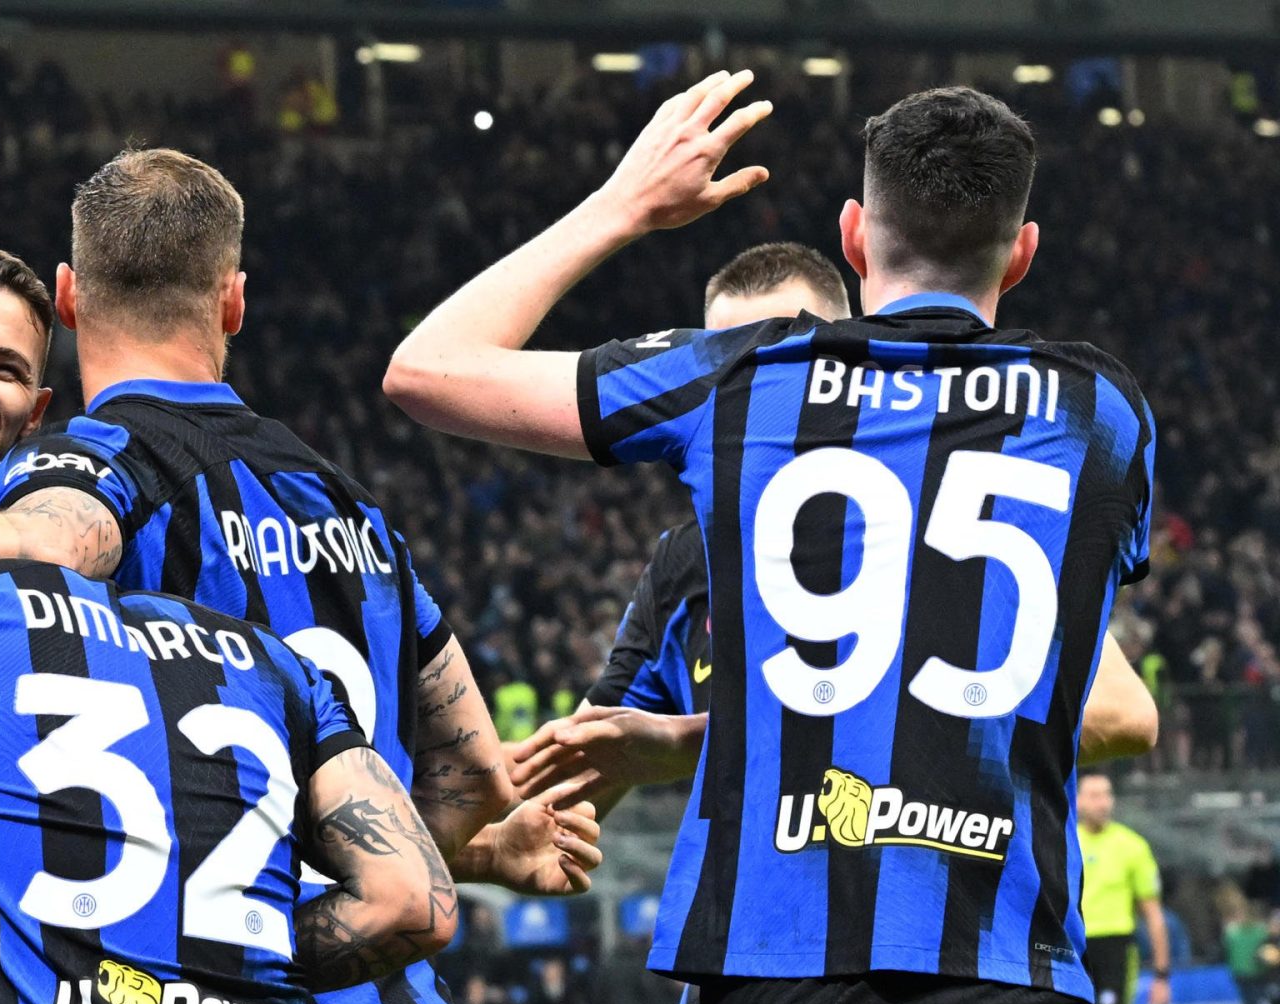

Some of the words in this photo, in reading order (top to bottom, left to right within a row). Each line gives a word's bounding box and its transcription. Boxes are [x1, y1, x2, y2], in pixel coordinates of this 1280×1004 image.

[808, 355, 1059, 423] BASTONI
[221, 510, 392, 577] RNAUTOVIC
[754, 447, 1071, 718] 95
[17, 589, 255, 671] DIMARCO
[14, 673, 299, 962] 32
